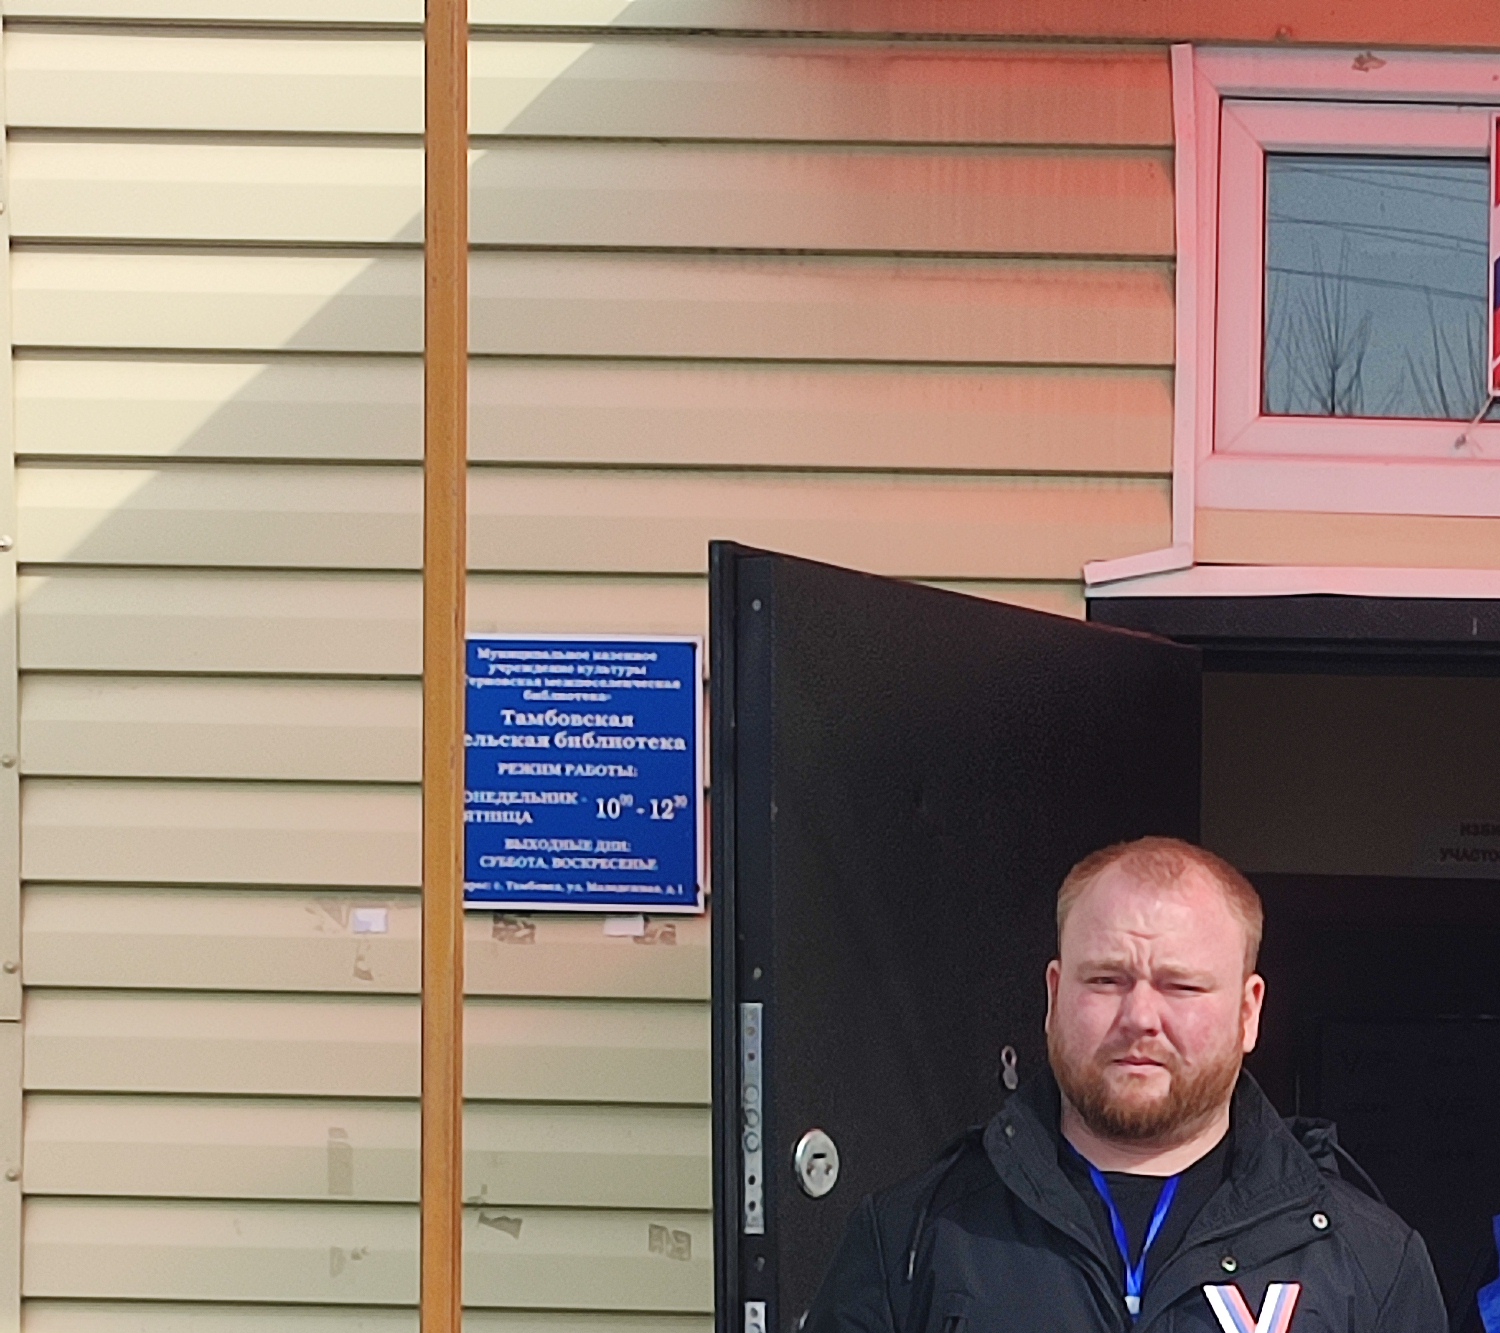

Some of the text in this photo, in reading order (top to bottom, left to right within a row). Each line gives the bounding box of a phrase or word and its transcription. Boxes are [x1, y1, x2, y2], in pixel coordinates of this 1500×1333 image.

[500, 709, 634, 728] Тамбовская
[464, 731, 686, 751] ельская библиотека
[497, 762, 561, 776] РЕЖИМ
[464, 791, 578, 805] ОНЕДЕЛЬНИК
[464, 810, 533, 826] ЯТНИЦА
